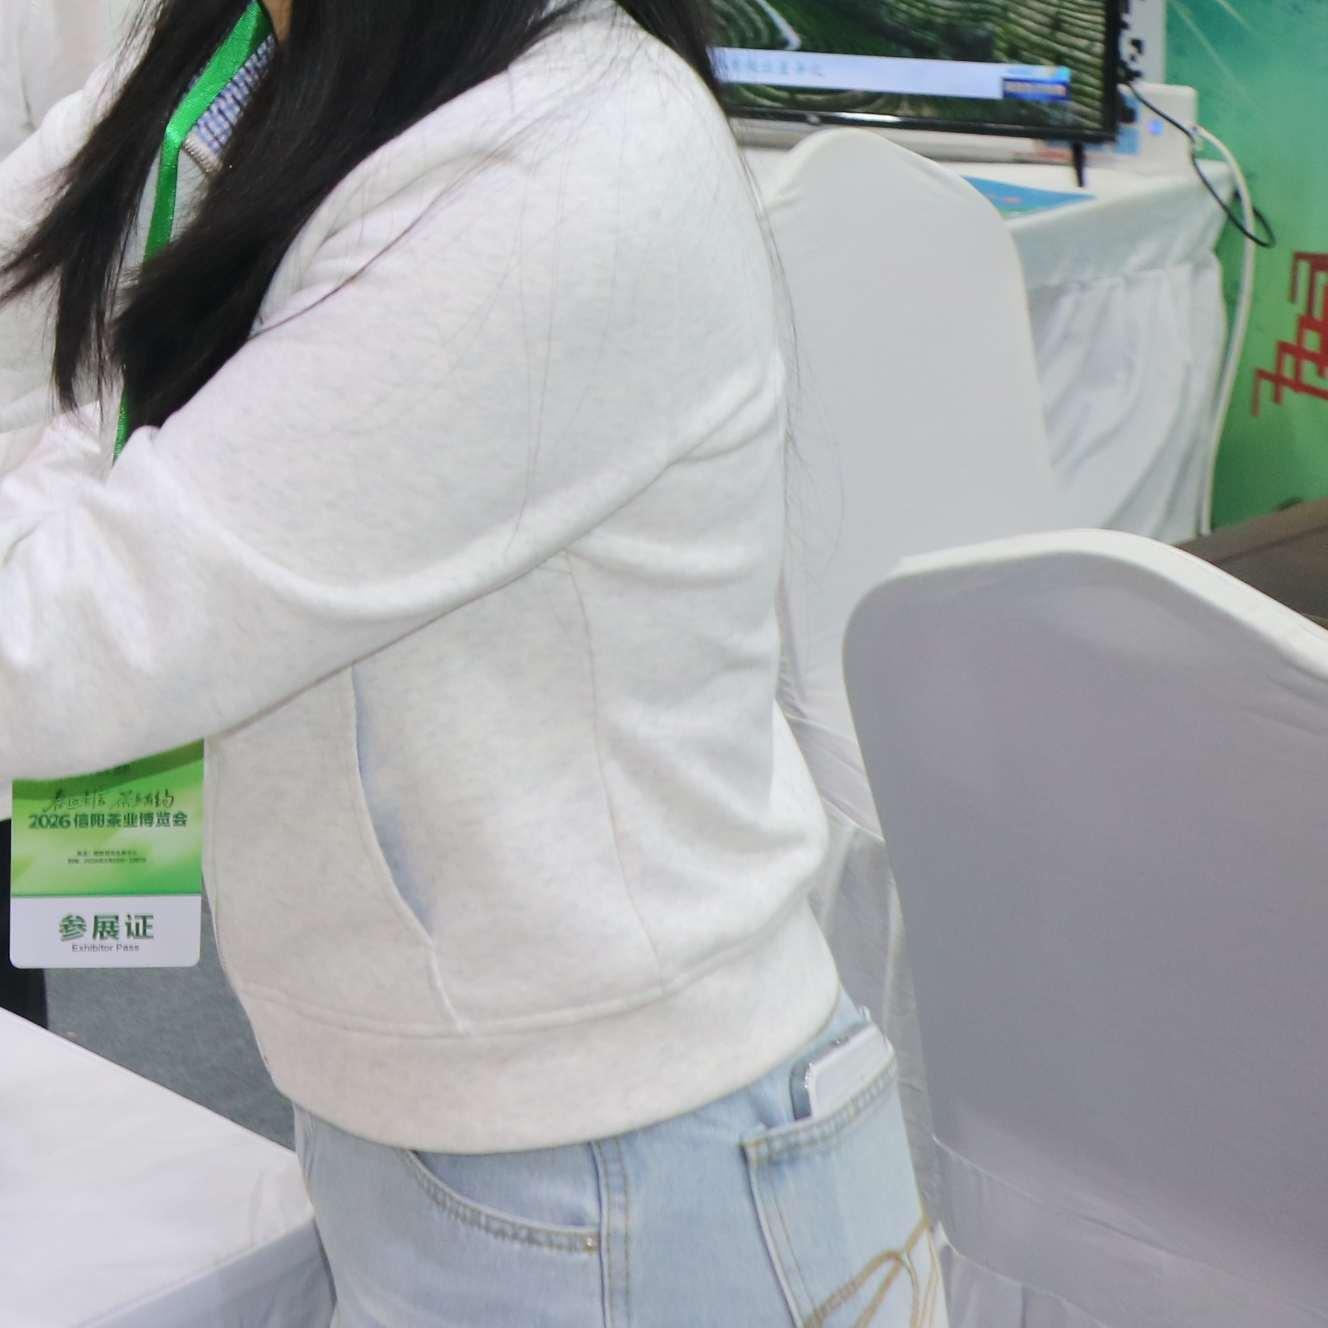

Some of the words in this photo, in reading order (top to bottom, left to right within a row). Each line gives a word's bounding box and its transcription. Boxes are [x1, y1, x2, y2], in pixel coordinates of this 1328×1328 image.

[27, 810, 188, 830] 2026信阳茶业博览会
[57, 913, 155, 943] 参展证
[71, 943, 113, 954] Exhibitor
[116, 943, 140, 953] Pass
